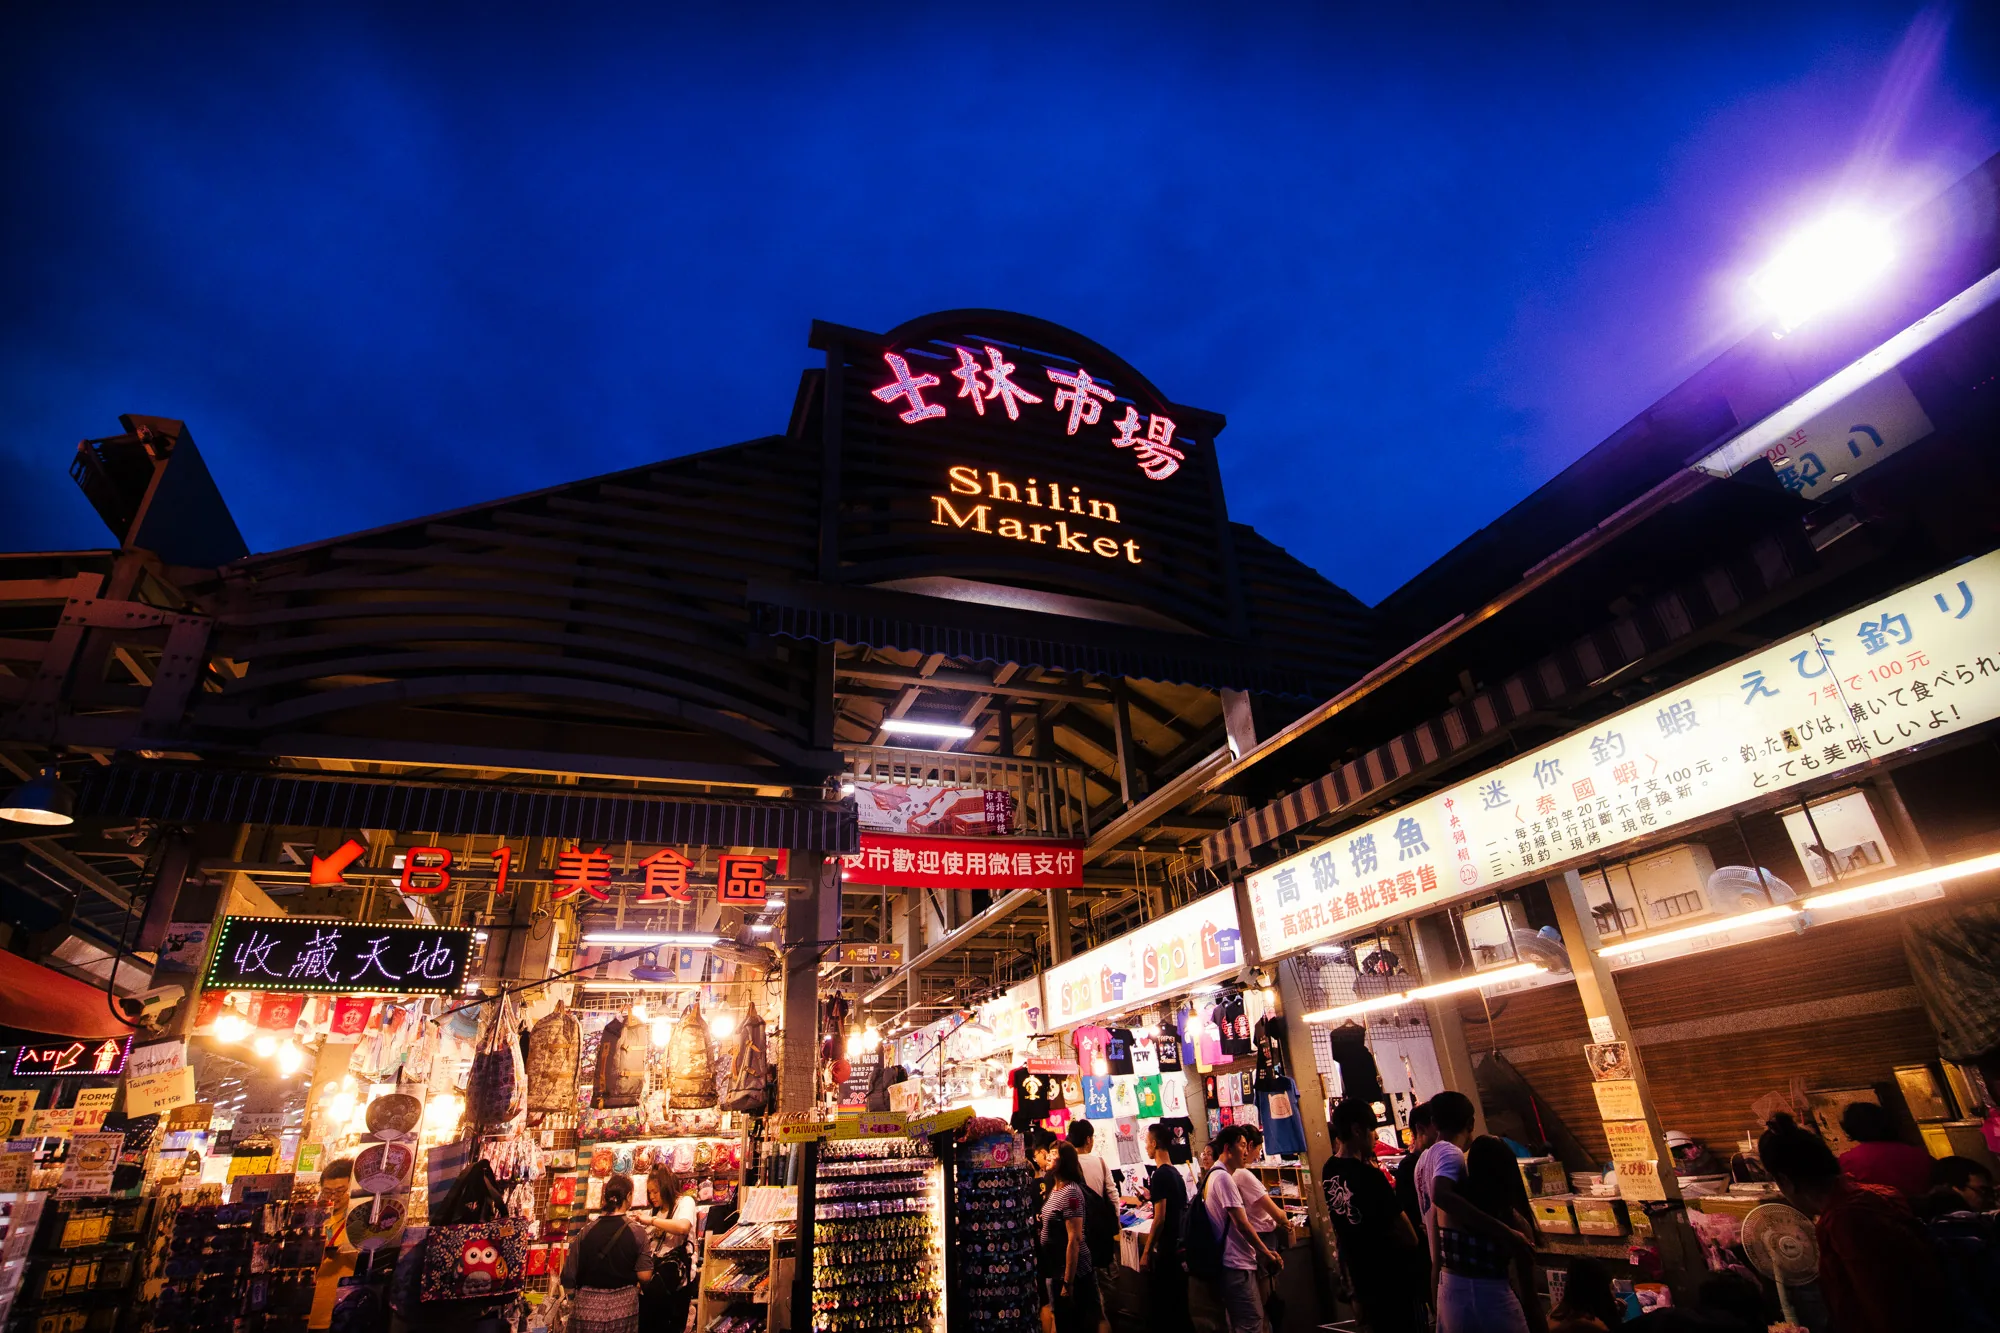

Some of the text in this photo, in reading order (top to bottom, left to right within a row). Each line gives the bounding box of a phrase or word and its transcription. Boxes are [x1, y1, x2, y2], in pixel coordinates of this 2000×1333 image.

[872, 346, 1185, 481] 士林市場
[949, 466, 1121, 524] Shilin
[931, 496, 1142, 564] Market
[1479, 698, 1701, 812] 迷你釣蝦
[1273, 817, 1431, 908] 高級撈魚
[1460, 866, 1478, 883] 226
[1280, 863, 1438, 939] 高級孔雀魚批發零售
[234, 929, 455, 982] 收藏天地
[1133, 1051, 1150, 1062] TW
[791, 1125, 822, 1135] TAIWAN
